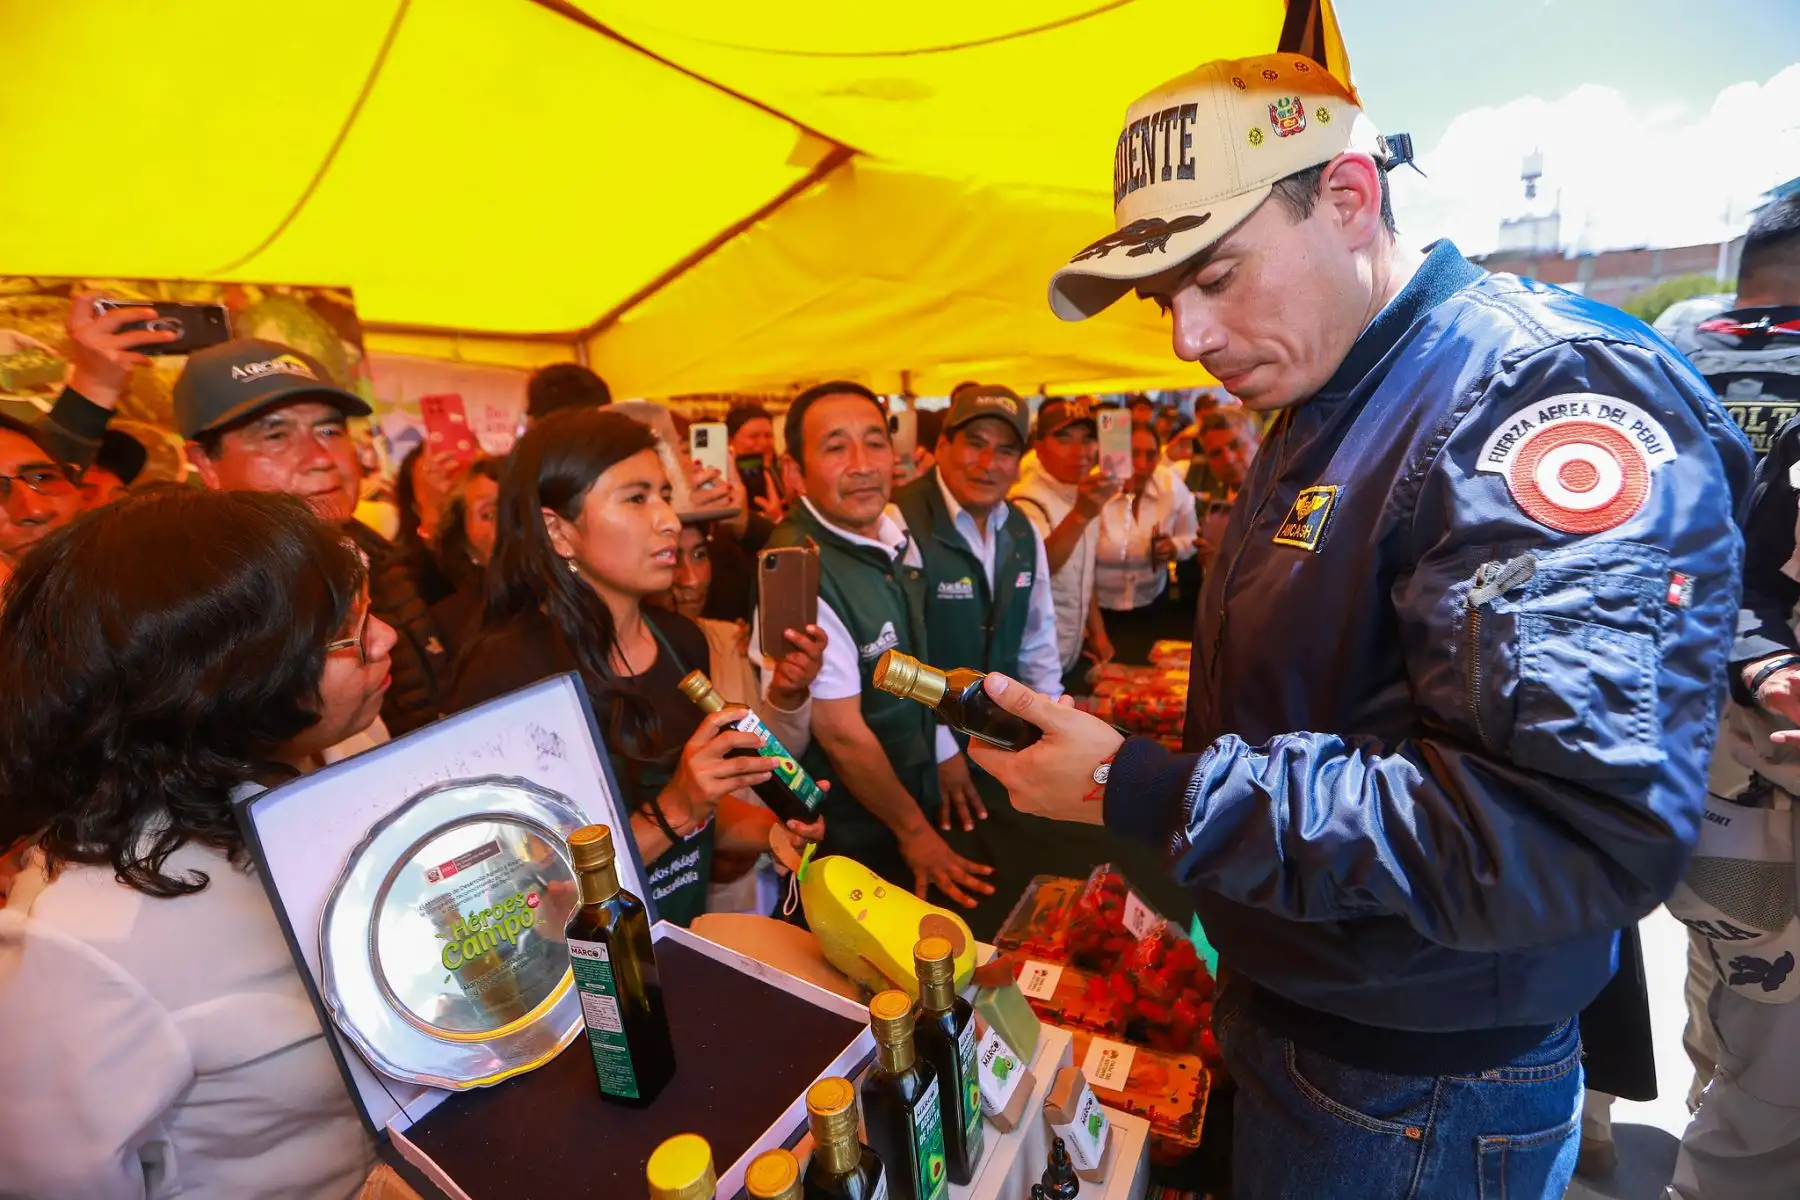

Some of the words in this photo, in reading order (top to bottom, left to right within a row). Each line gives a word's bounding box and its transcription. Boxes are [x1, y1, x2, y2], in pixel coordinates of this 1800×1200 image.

[1114, 103, 1198, 211] DENTE
[1488, 419, 1536, 464] FUERZA
[1538, 402, 1591, 424] AEREA
[1597, 404, 1628, 427] DEL
[1629, 419, 1664, 455] PERU
[1728, 407, 1797, 432] OLT
[442, 907, 536, 970] Campo
[450, 891, 525, 941] Héroes
[571, 946, 599, 958] MARCO
[982, 1040, 999, 1068] MARCO
